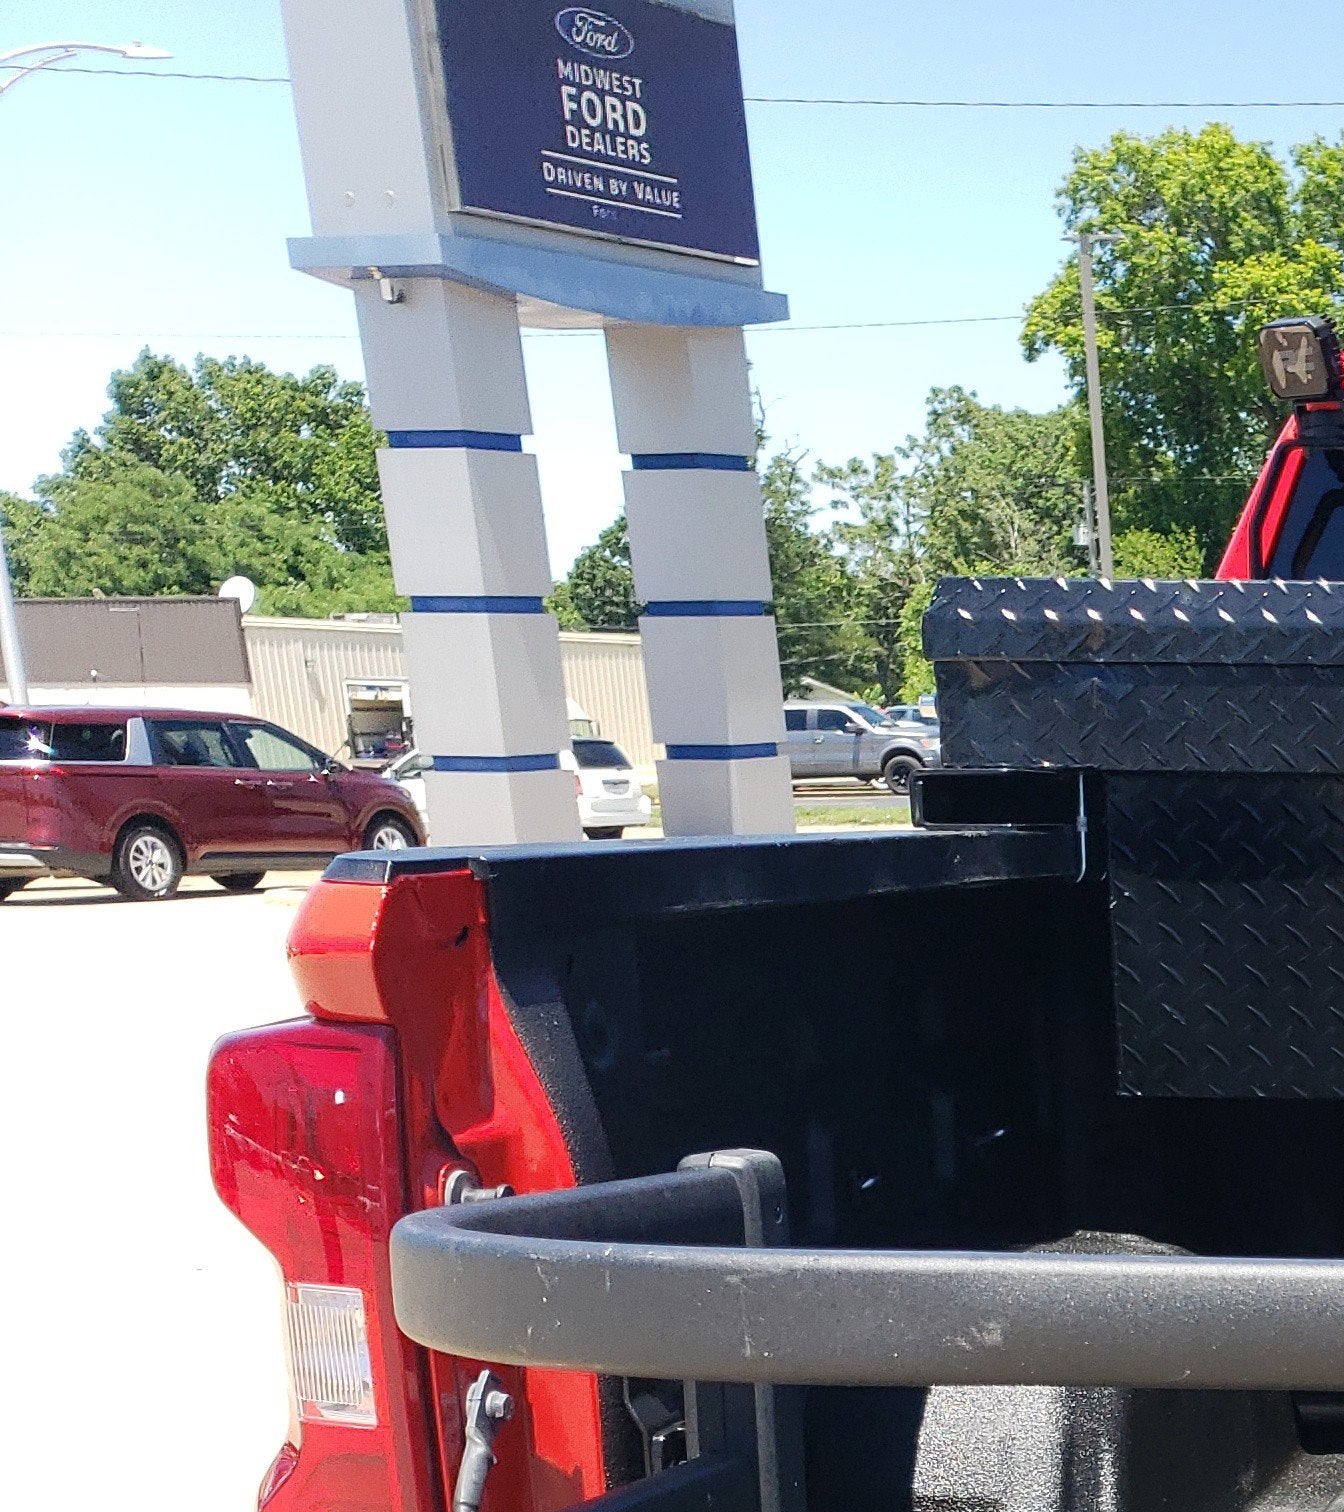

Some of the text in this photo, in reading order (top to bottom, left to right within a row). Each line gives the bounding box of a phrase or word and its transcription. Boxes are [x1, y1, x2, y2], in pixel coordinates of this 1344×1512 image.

[571, 13, 620, 52] Ford
[557, 58, 642, 98] MIDWEST
[561, 85, 648, 137] FORD
[566, 124, 651, 165] DEALERS
[542, 161, 682, 209] DRIVEN BY VALUE
